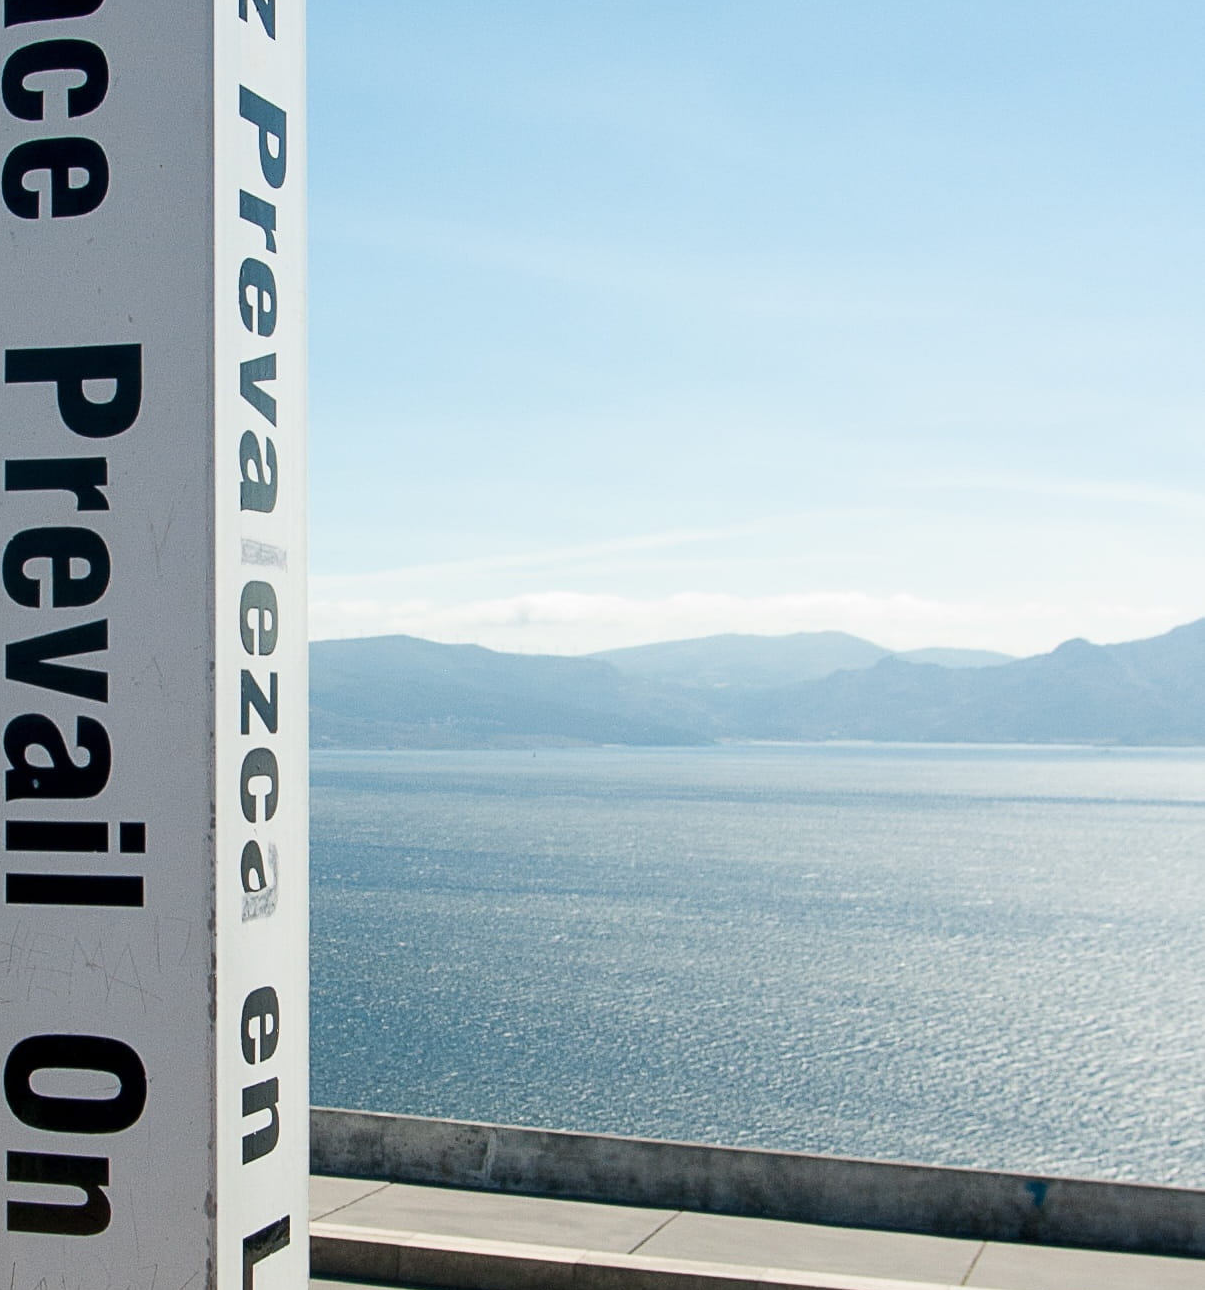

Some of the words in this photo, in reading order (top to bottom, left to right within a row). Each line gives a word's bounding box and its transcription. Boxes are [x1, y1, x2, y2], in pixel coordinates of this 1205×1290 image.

[2, 343, 145, 908] Prevail
[3, 1034, 146, 1236] On
[240, 985, 280, 1165] en
